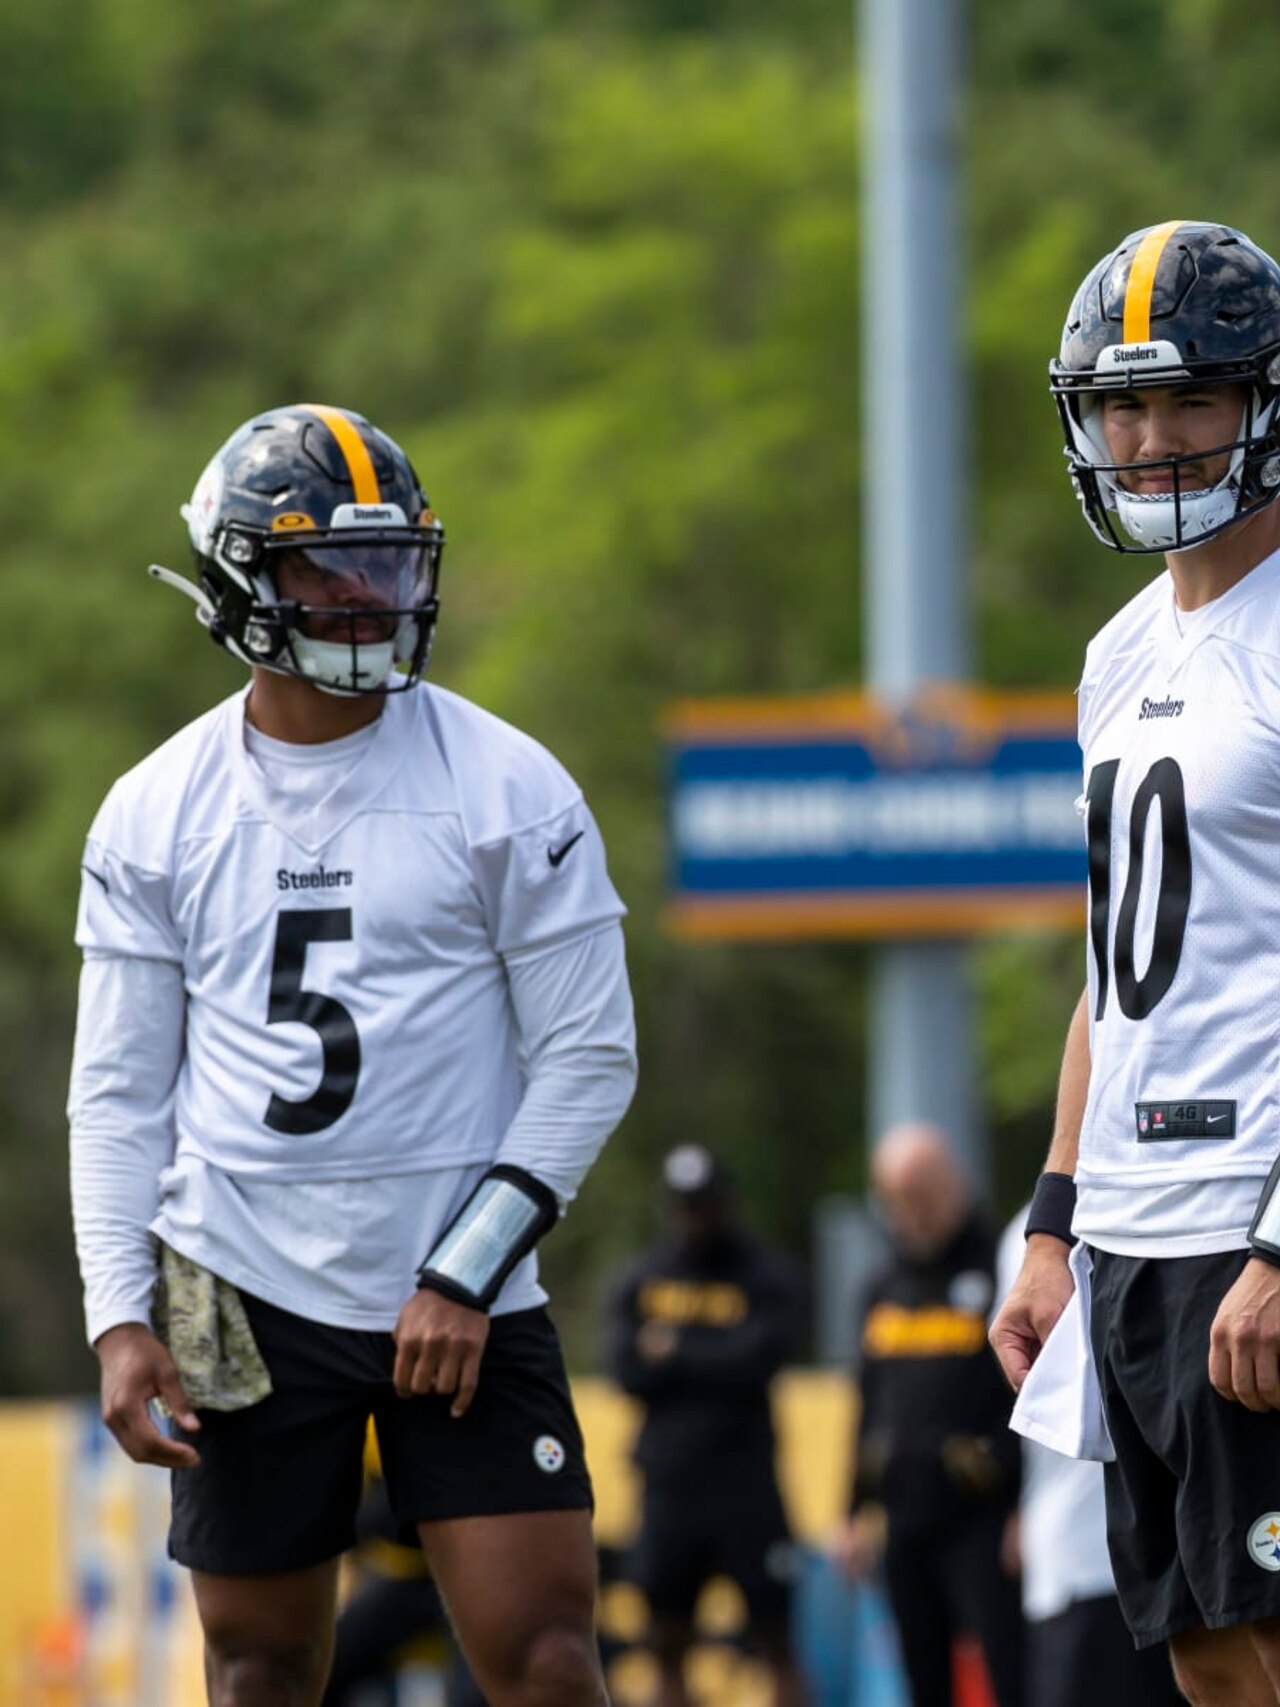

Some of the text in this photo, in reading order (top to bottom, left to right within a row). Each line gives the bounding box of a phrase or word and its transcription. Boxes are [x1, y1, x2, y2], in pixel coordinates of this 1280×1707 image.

[1114, 346, 1158, 363] Steelers
[1138, 694, 1184, 720] Steelers
[277, 865, 354, 890] Steelers
[1085, 757, 1192, 1021] 10
[263, 907, 361, 1136] 5
